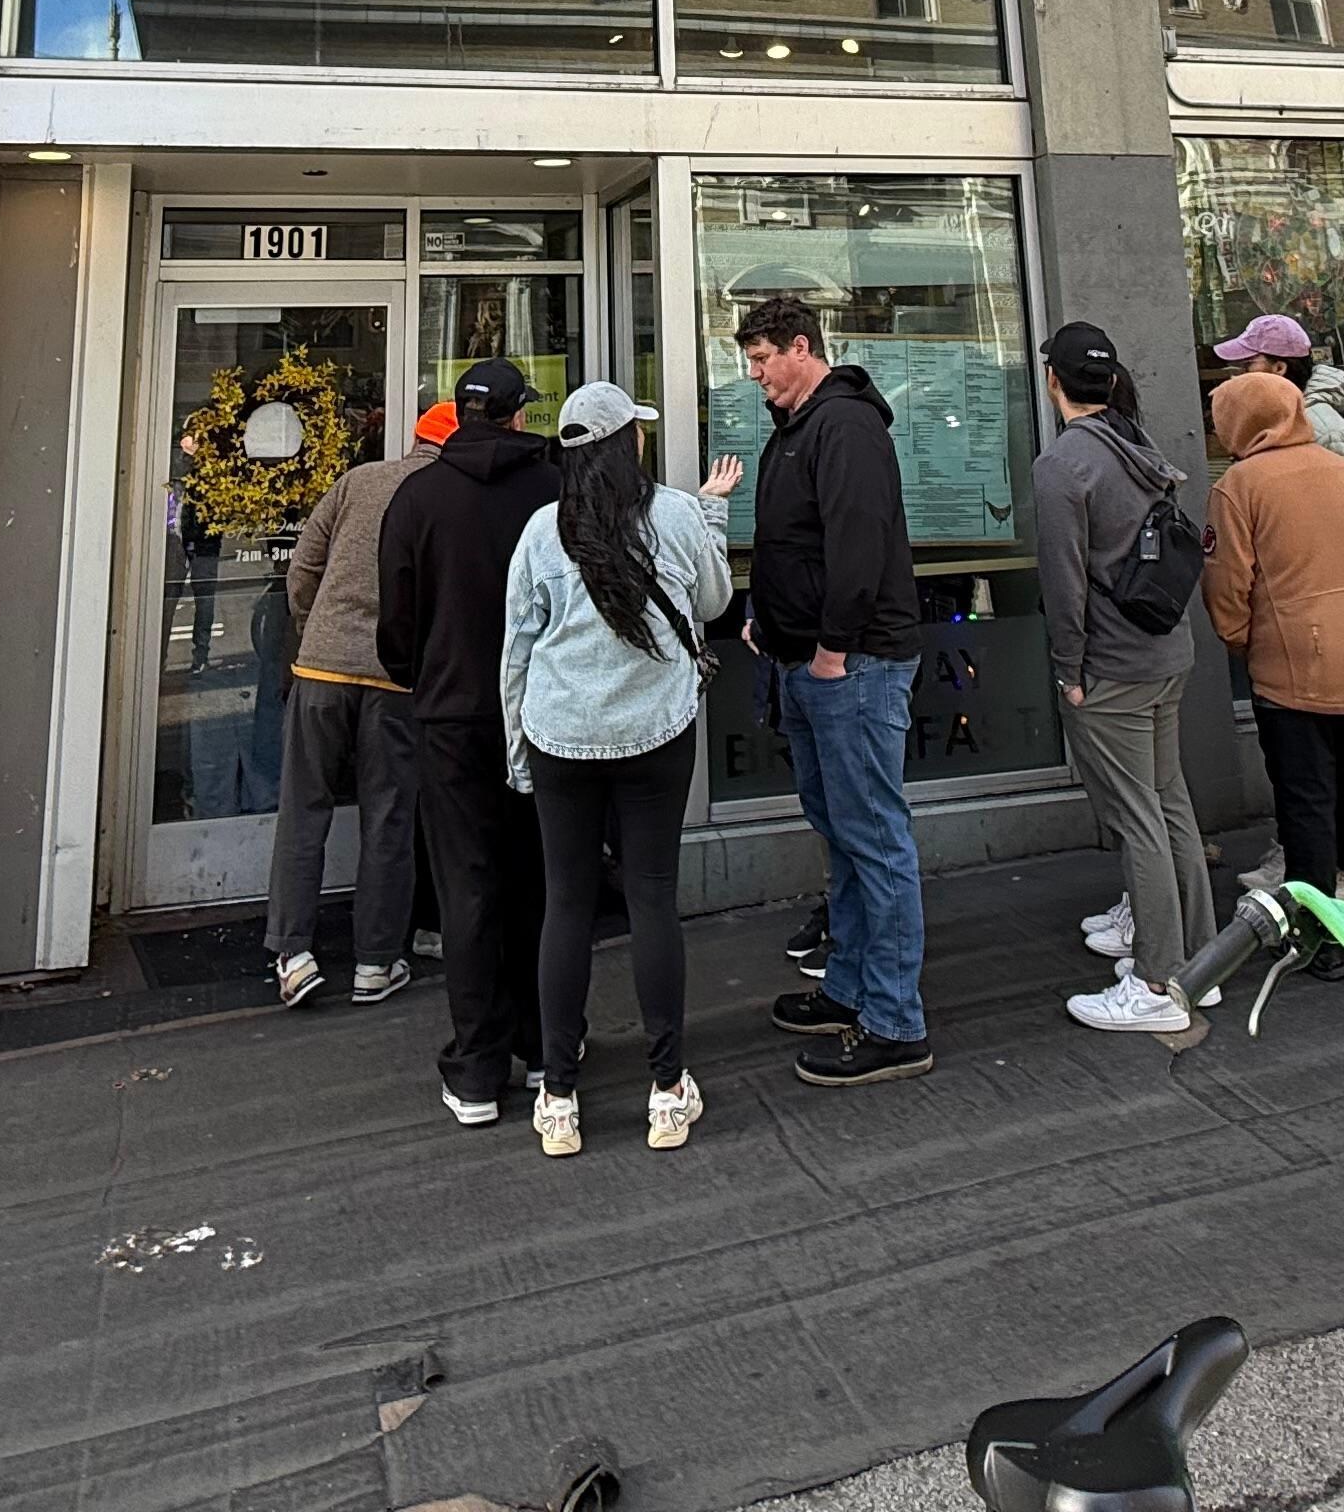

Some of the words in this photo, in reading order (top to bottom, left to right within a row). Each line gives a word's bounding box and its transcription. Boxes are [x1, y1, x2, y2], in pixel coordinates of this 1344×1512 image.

[249, 226, 323, 258] 1901
[426, 236, 442, 248] NO
[537, 391, 559, 402] ent
[235, 549, 262, 562] 7am
